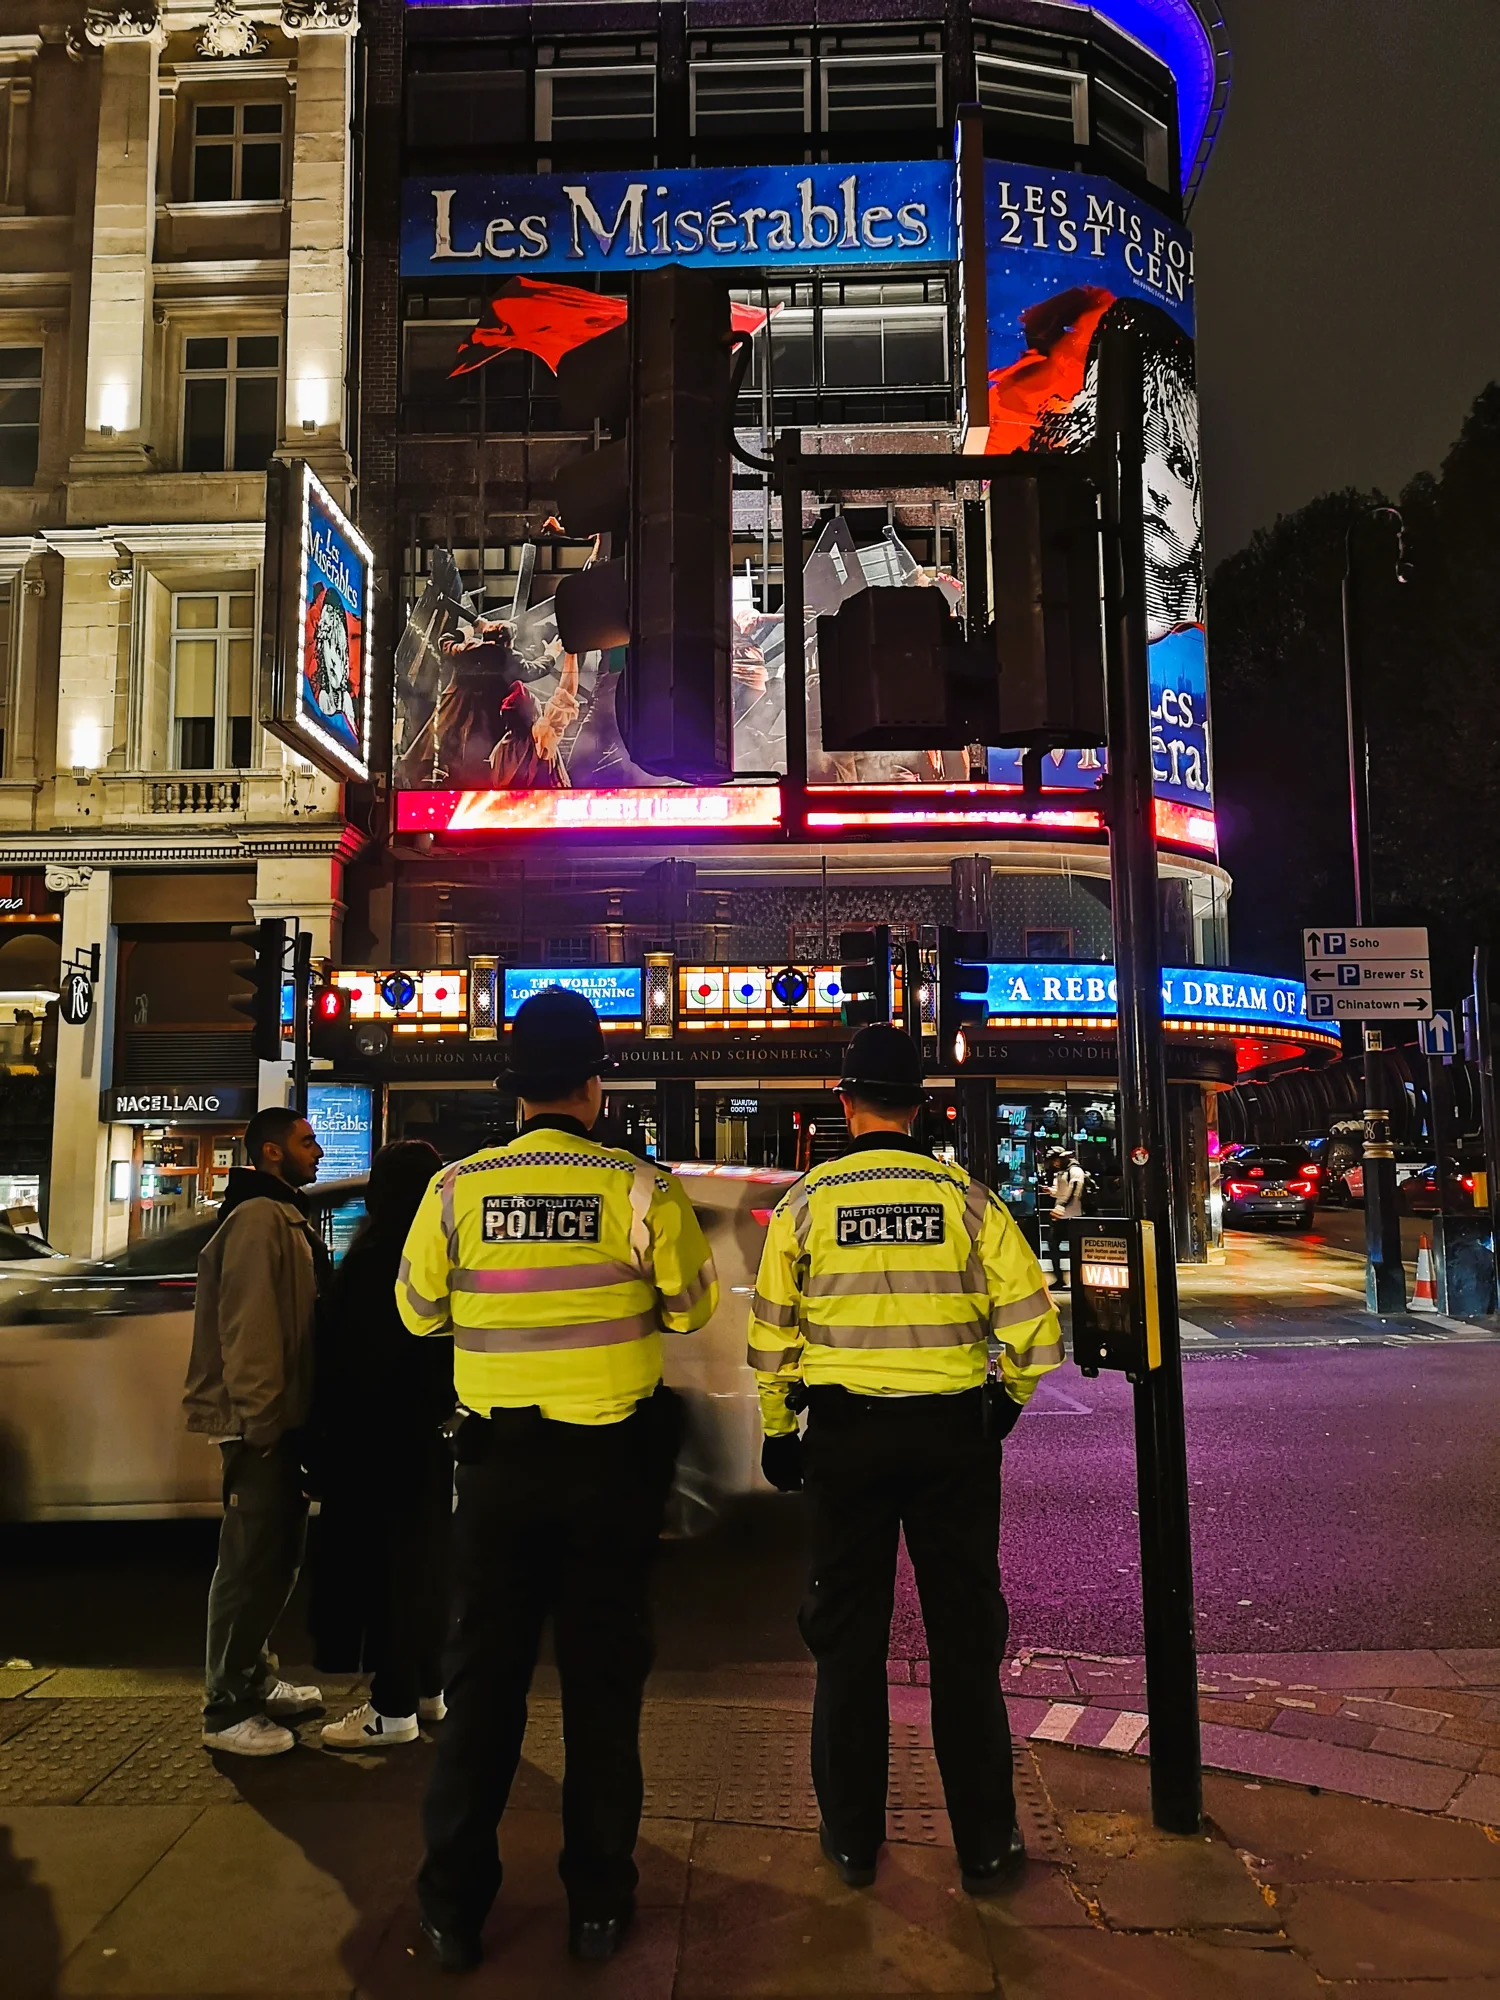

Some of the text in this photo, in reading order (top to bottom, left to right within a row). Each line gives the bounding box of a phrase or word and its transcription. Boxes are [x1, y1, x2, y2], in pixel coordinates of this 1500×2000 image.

[430, 175, 929, 260] Les Misérables
[998, 181, 1068, 217] LES
[1086, 195, 1142, 242] MIS
[1000, 211, 1195, 302] 21ST CEN
[325, 527, 340, 564] Les
[306, 519, 358, 609] Misérables
[1329, 935, 1380, 952] P Soho
[560, 977, 617, 988] WORLD'S
[1343, 966, 1424, 984] P Brewer St
[1183, 981, 1268, 1012] DREAM
[1272, 991, 1296, 1015] OF
[1316, 996, 1330, 1014] P
[1336, 999, 1400, 1009] Chinatown
[393, 1052, 465, 1064] CAMERON
[471, 1052, 512, 1063] MACK
[621, 1050, 684, 1061] BOUBLIL
[690, 1050, 721, 1061] AND
[116, 1095, 220, 1112] MACELLAIO
[326, 1107, 345, 1119] Les
[486, 1198, 595, 1208] METROPOLITAN
[840, 1206, 940, 1218] METROPOLITAN
[485, 1210, 595, 1238] POLICE
[840, 1216, 940, 1242] POLICE
[1084, 1239, 1127, 1249] PEDESTRIANS
[1085, 1265, 1129, 1287] WAIT
